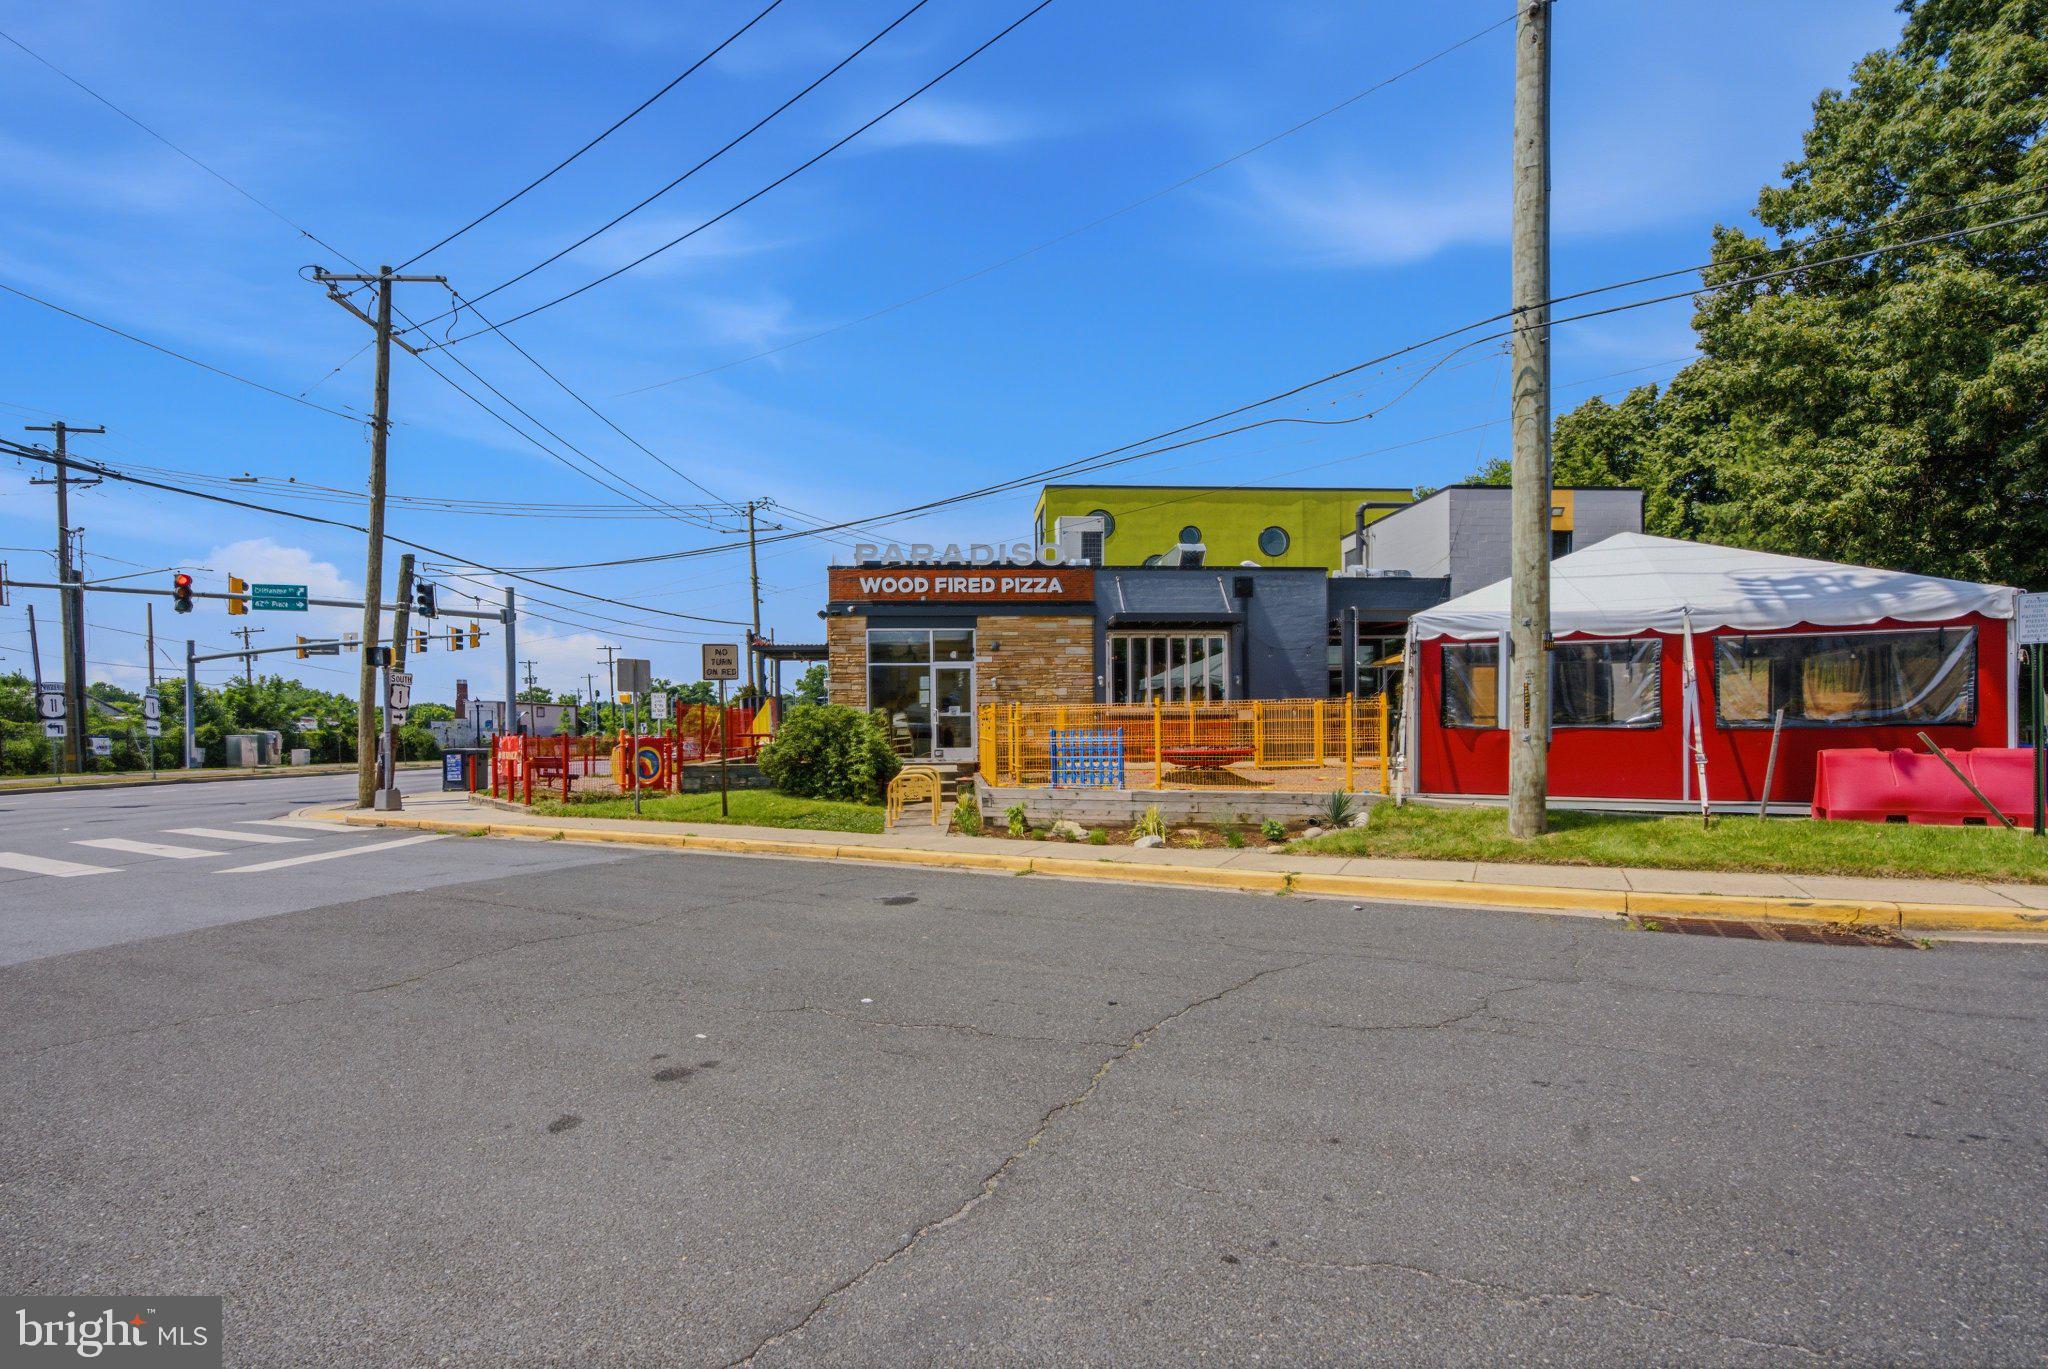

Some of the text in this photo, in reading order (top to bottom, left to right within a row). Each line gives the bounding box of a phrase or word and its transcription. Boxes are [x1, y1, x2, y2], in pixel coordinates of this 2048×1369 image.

[856, 543, 1066, 566] PARADISO
[859, 577, 1064, 594] WOOD FIRED PIZZA
[714, 648, 728, 656] NO
[711, 658, 733, 666] TURN
[706, 668, 737, 676] ON RED
[390, 674, 412, 683] SOUTH
